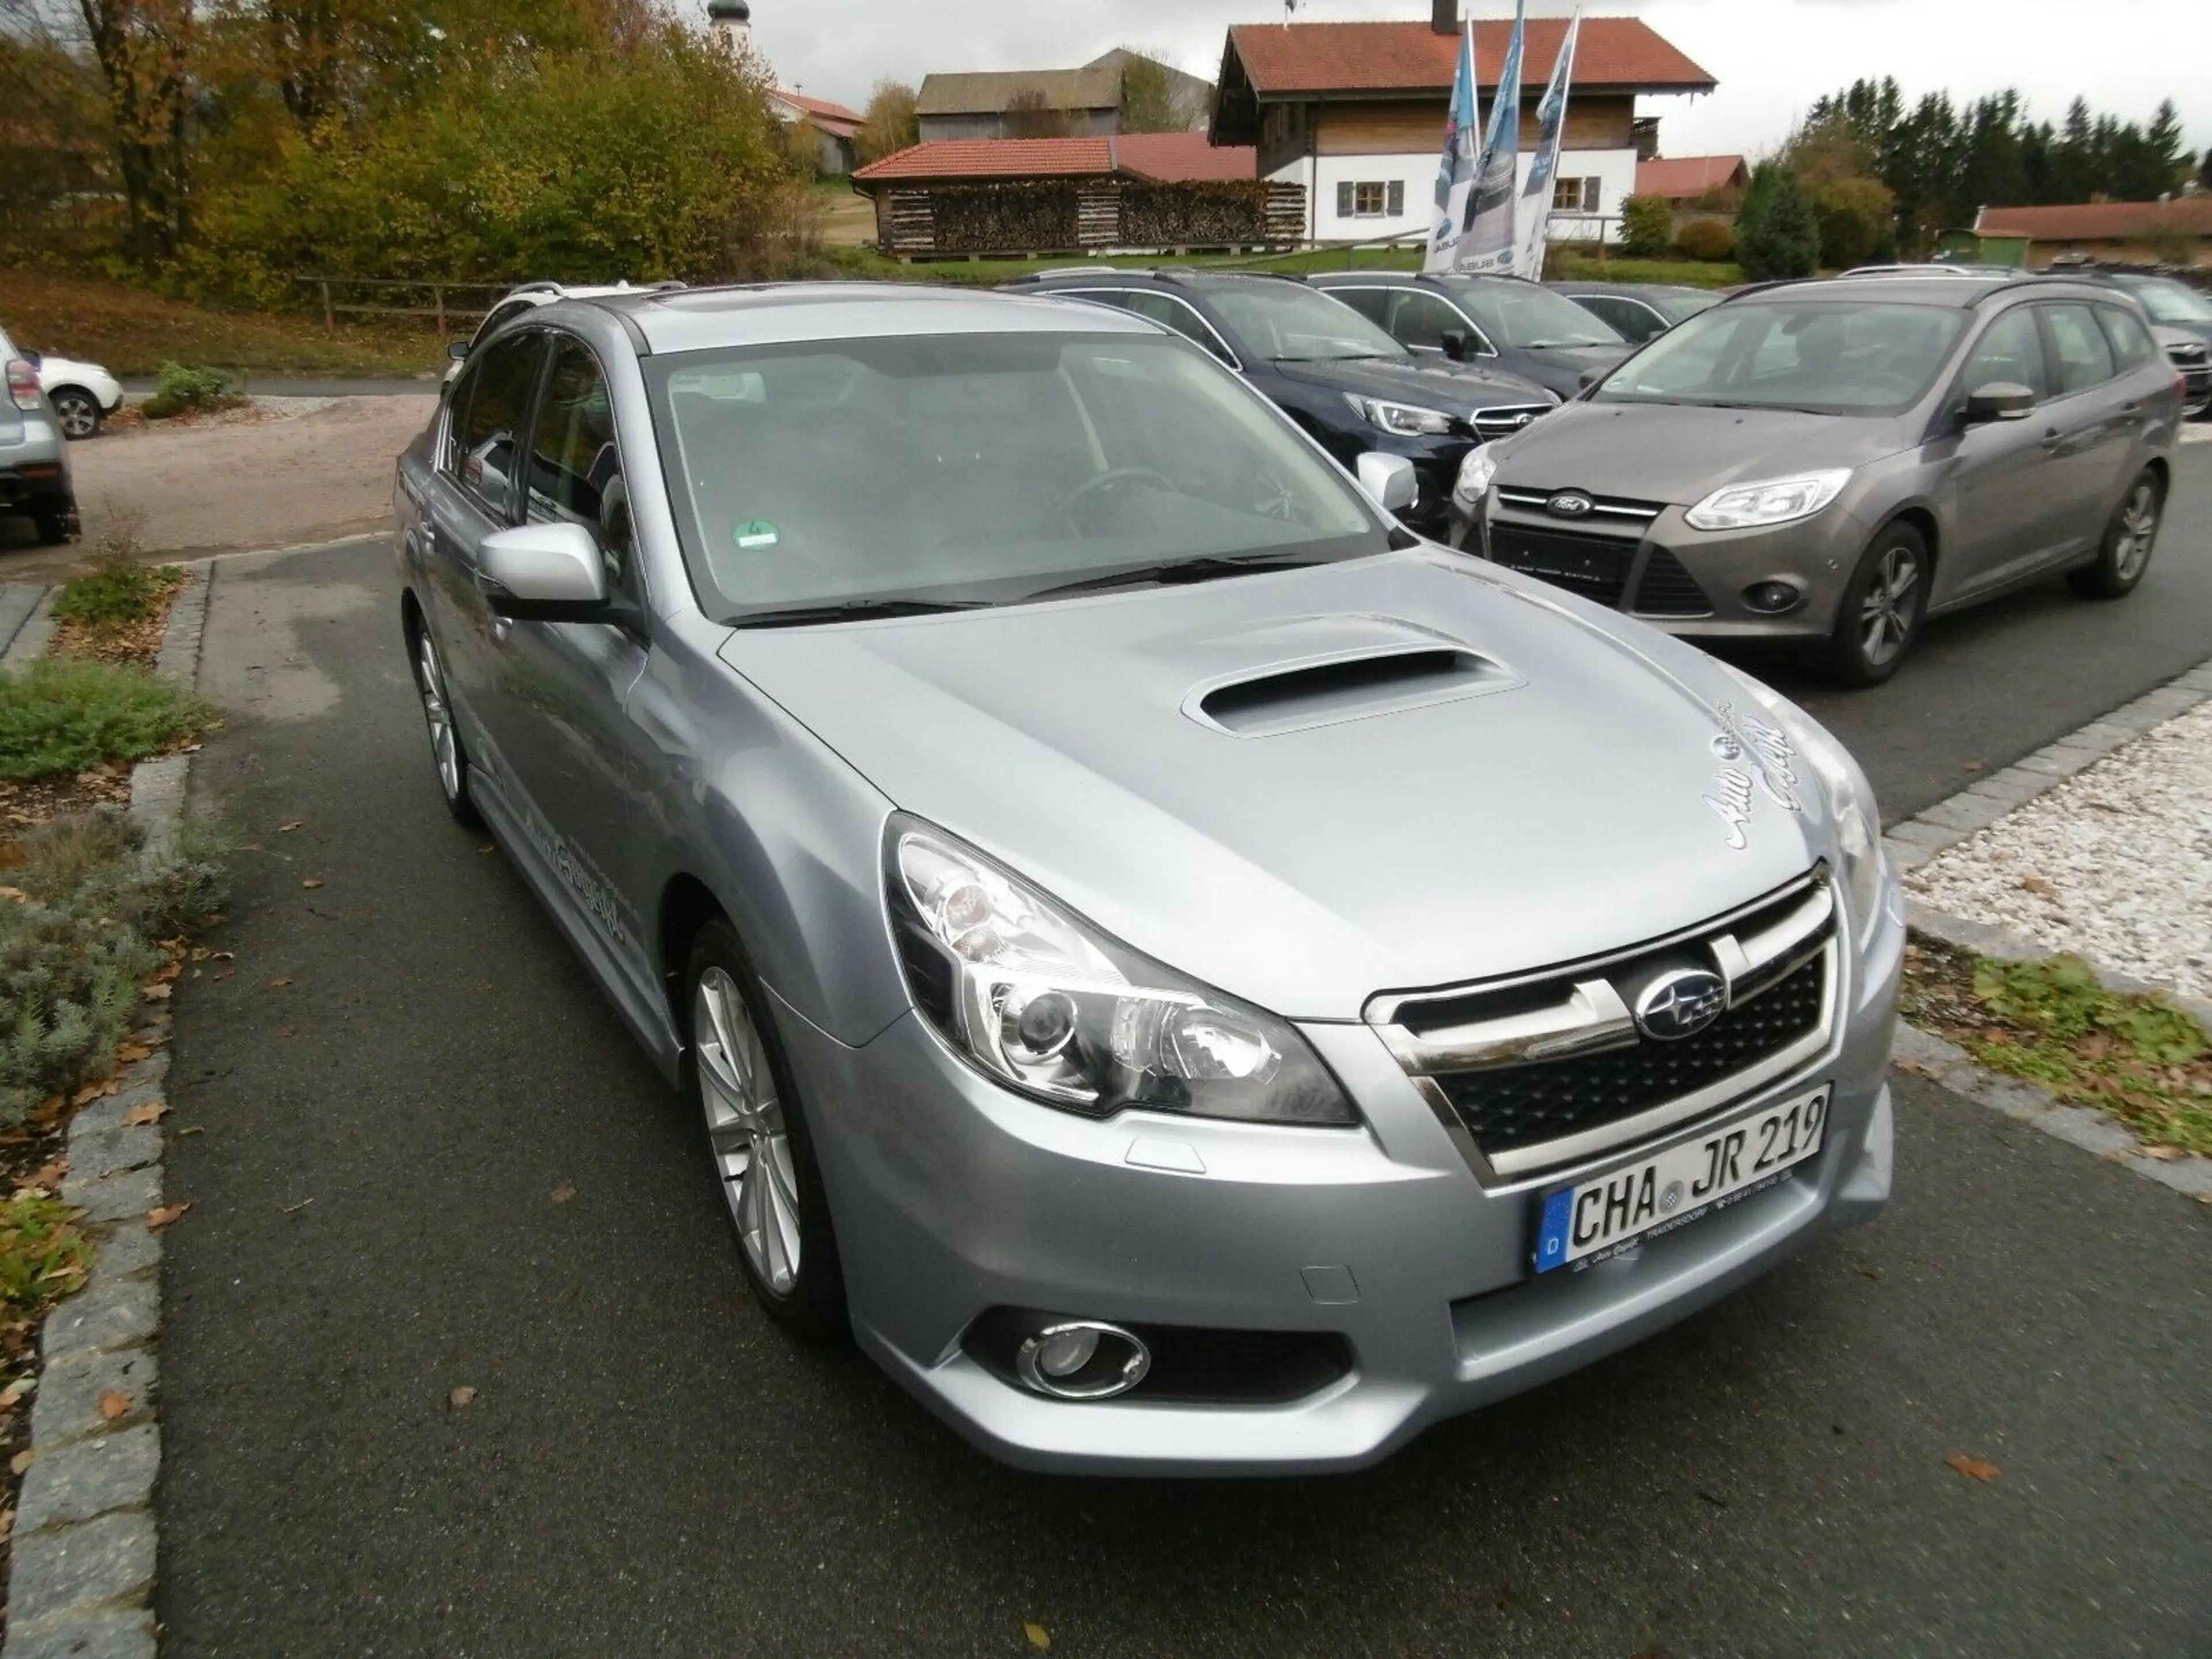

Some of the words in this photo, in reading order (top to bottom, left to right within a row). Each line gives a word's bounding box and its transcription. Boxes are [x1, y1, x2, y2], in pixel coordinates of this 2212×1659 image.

[748, 521, 762, 535] 4
[1573, 1166, 1657, 1247] CHA
[1692, 1129, 1748, 1198] JR
[1753, 1095, 1825, 1173] 219
[1547, 1237, 1559, 1255] D
